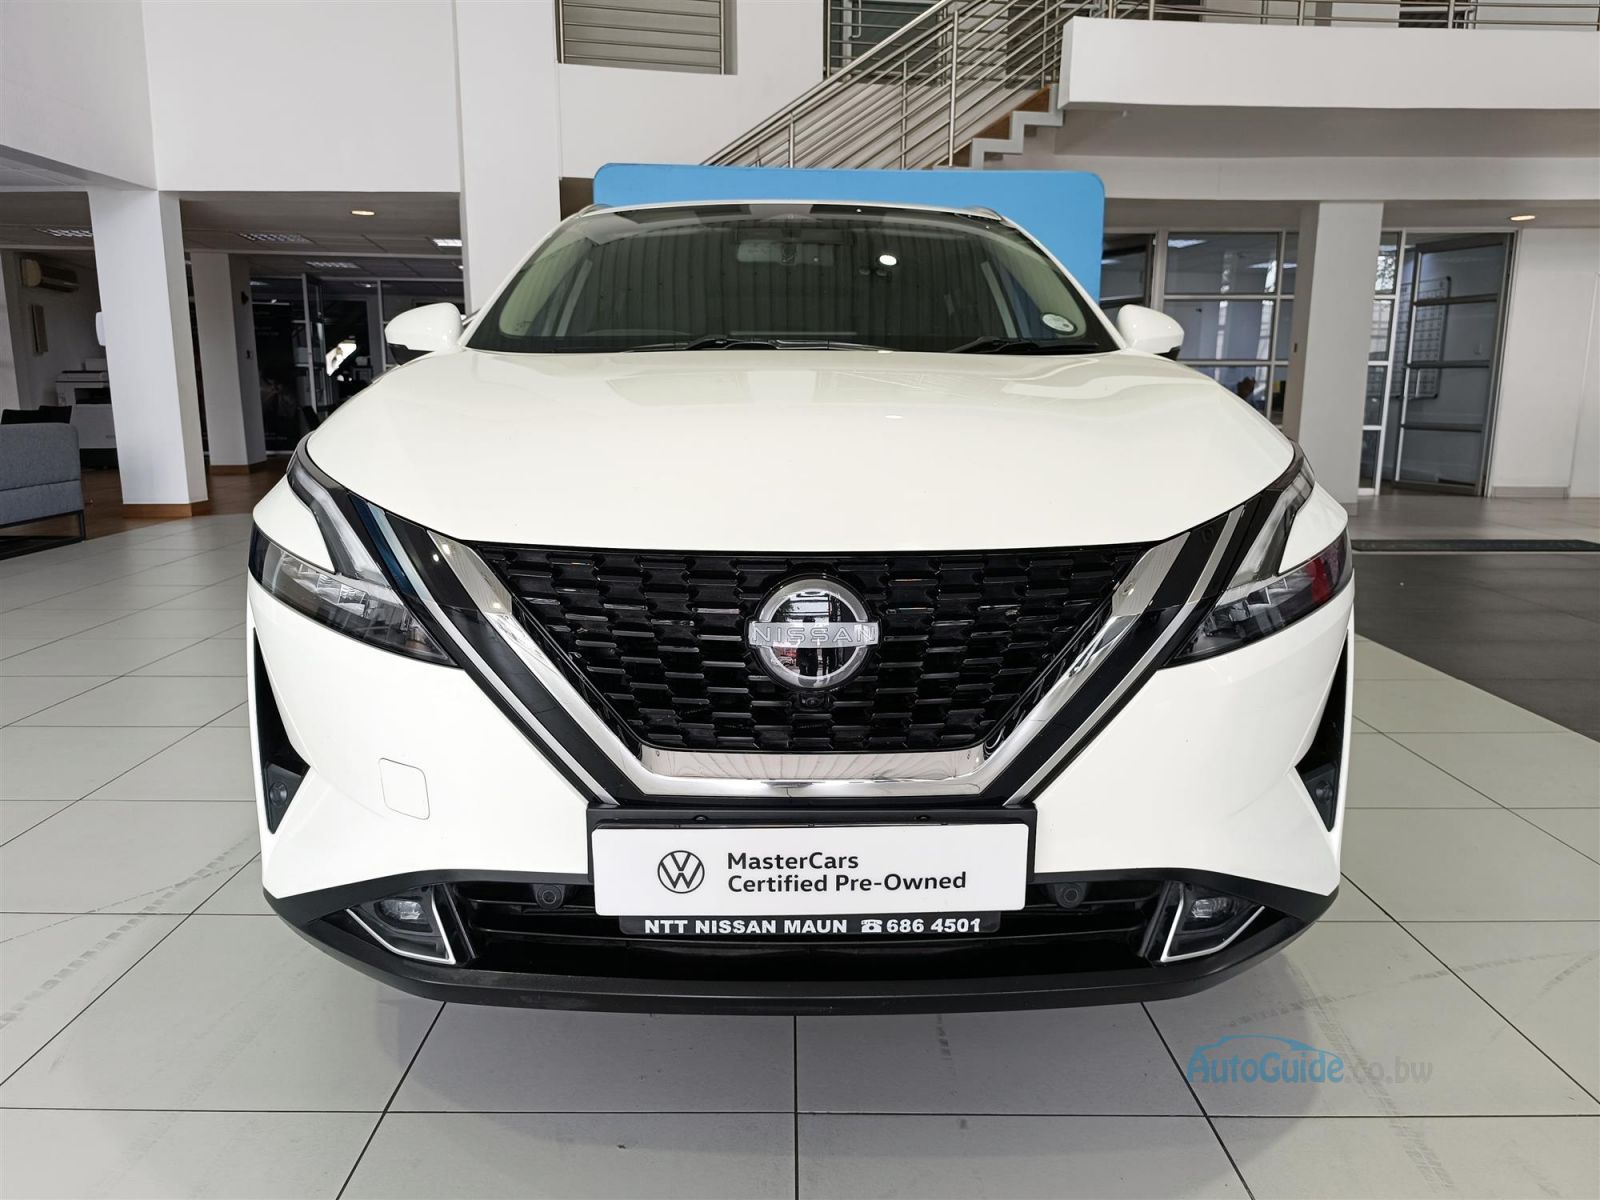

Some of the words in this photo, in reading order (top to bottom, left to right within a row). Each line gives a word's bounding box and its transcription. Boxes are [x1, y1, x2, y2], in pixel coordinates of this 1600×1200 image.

[752, 626, 876, 642] NISSAN
[727, 852, 859, 870] MasterCars
[728, 874, 828, 892] Certified
[836, 871, 966, 891] Pre-Owned
[644, 919, 688, 934] NTT
[695, 919, 776, 934] NISSAN
[784, 919, 847, 933] MAUN
[886, 918, 925, 933] 686
[930, 918, 981, 932] 4501
